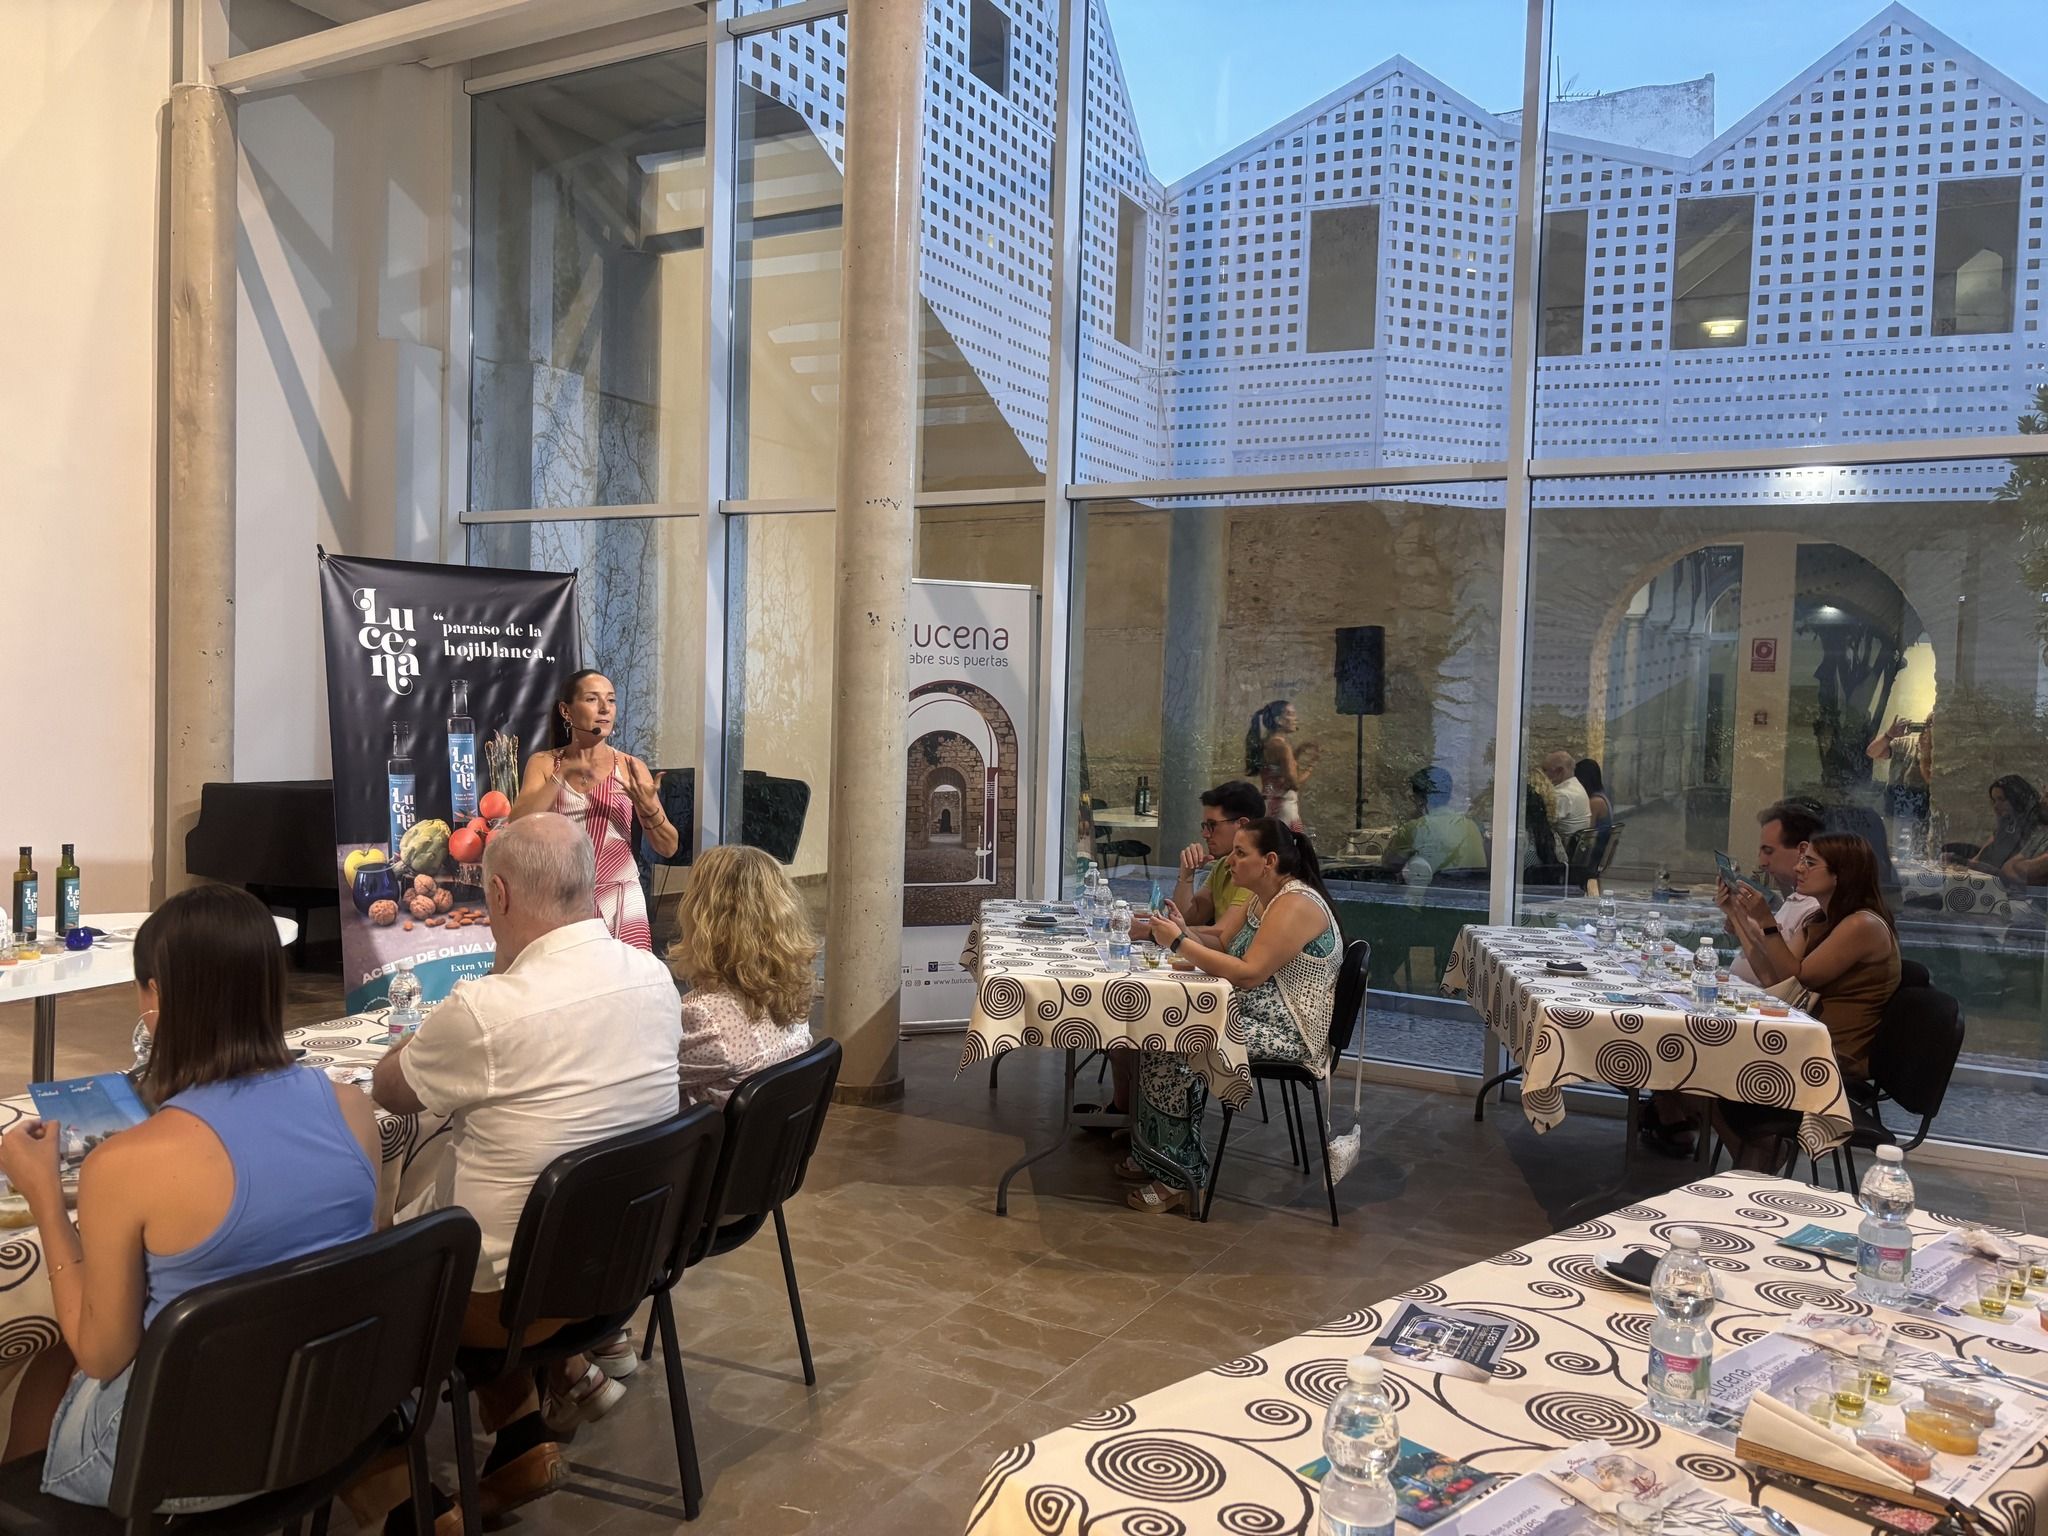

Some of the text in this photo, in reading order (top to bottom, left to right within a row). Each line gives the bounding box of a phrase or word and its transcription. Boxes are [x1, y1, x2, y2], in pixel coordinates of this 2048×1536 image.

[505, 622, 524, 637] de
[529, 623, 543, 638] la
[909, 624, 1009, 651] ucena
[909, 652, 1009, 668] abre sus puertas
[416, 950, 437, 964] DE
[439, 943, 483, 958] OLIVA
[451, 963, 475, 972] Extra
